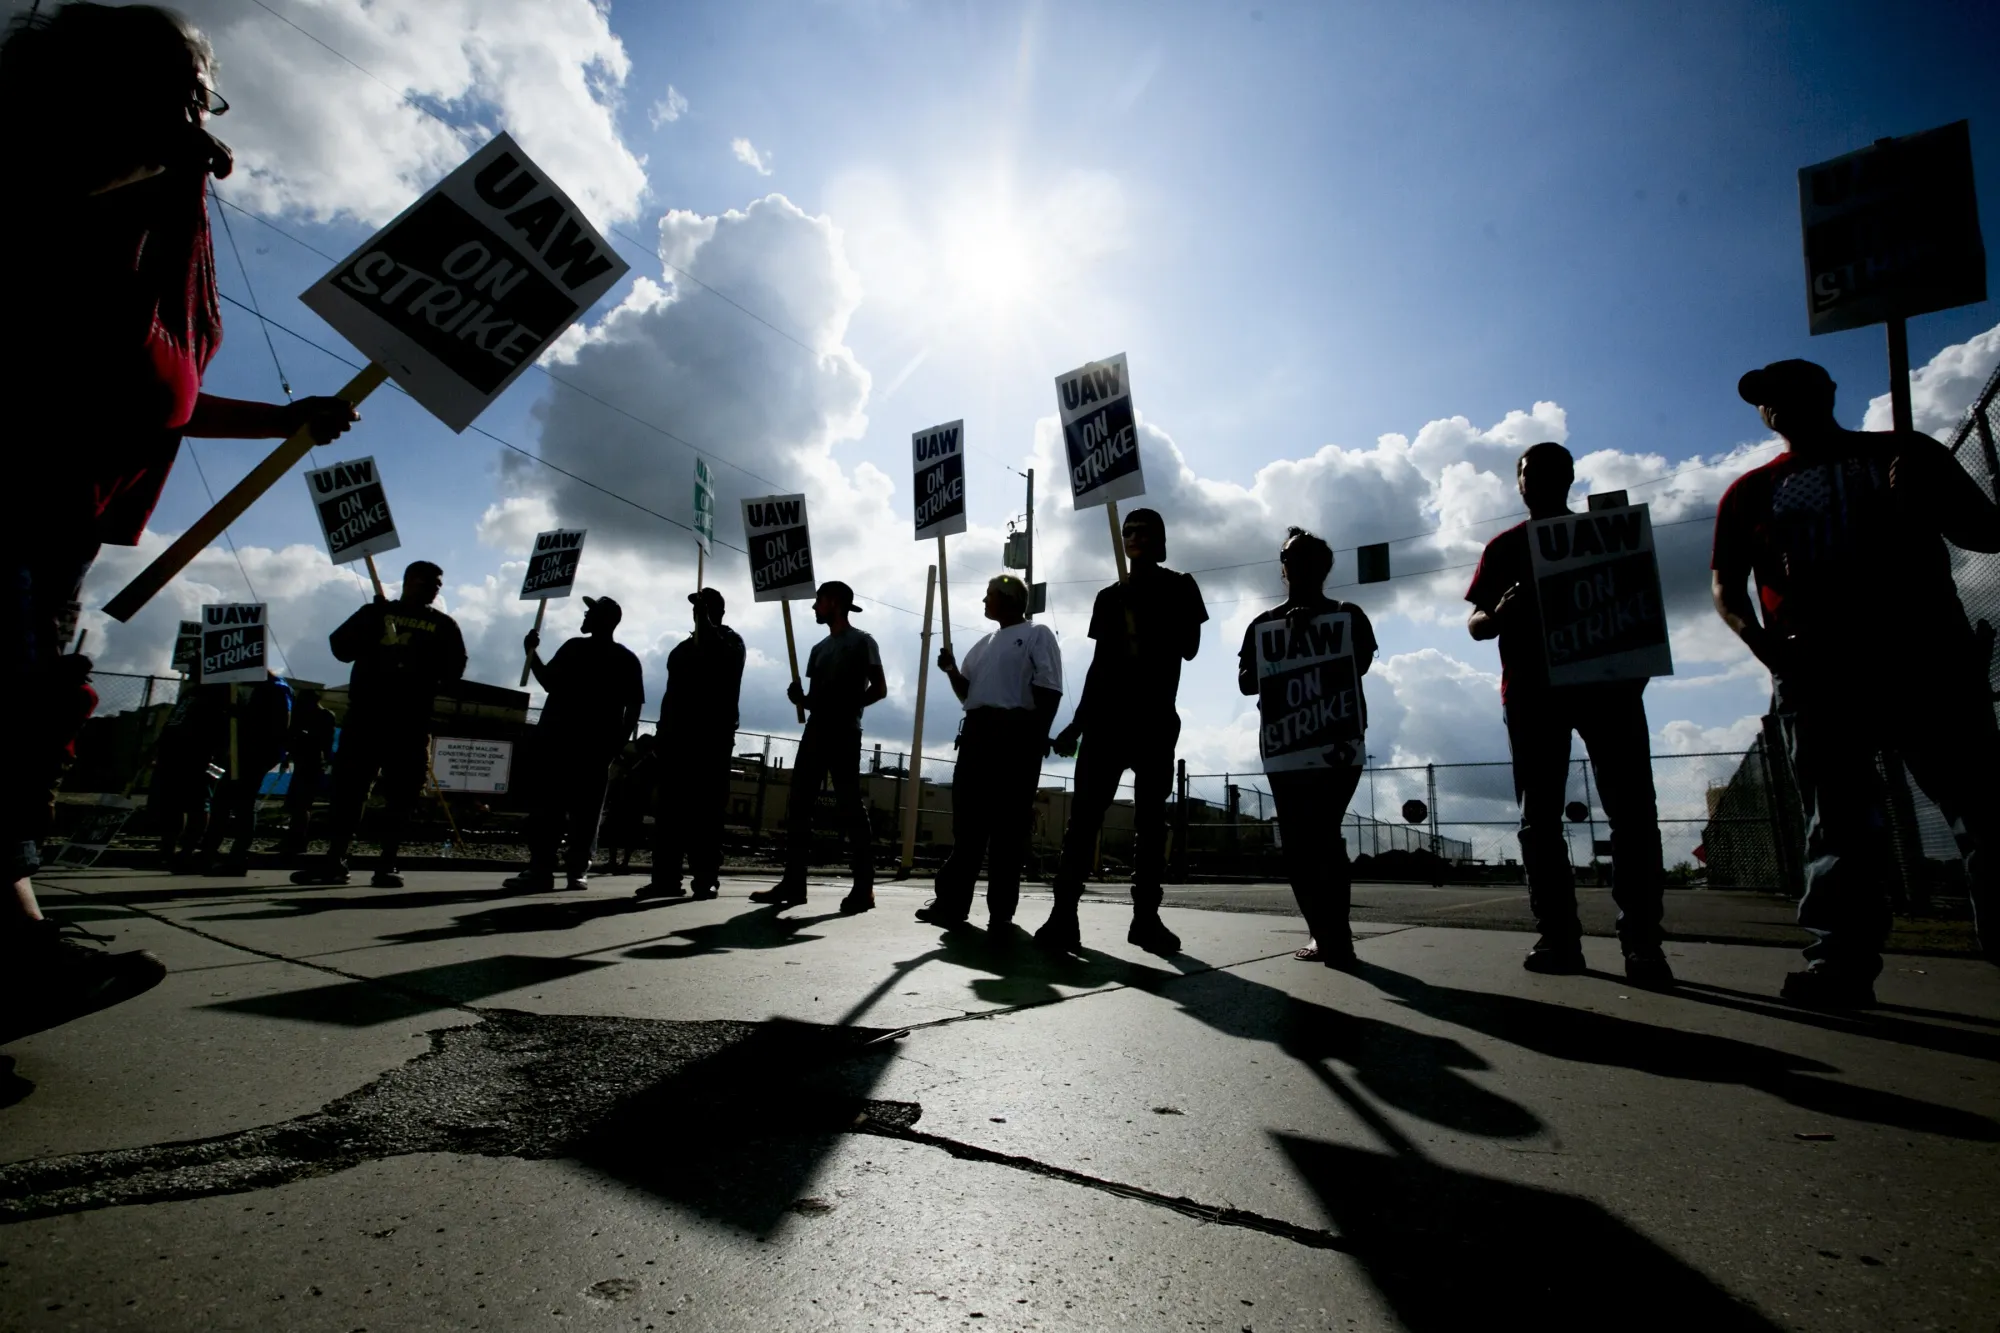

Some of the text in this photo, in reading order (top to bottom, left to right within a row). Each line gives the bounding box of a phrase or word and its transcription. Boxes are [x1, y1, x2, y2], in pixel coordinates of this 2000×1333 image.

[474, 151, 613, 290] UAW
[442, 240, 528, 299] ON
[341, 251, 543, 366] STRIKE
[1062, 363, 1121, 411] UAW
[915, 428, 959, 462] UAW
[1082, 410, 1109, 450] ON
[312, 461, 373, 494] UAW
[926, 464, 945, 494] ON
[1073, 424, 1135, 492] STRIKE
[338, 492, 364, 520] ON
[747, 500, 801, 527] UAW
[915, 477, 962, 528] STRIKE
[329, 501, 389, 550] STRIKE
[537, 532, 582, 550] UAW
[765, 533, 788, 560] ON
[1536, 511, 1642, 562] UAW
[524, 561, 575, 592] STRIKE
[541, 551, 562, 569] ON
[754, 547, 810, 590] STRIKE
[1573, 566, 1616, 612] ON
[207, 606, 262, 626] UAW
[1547, 589, 1658, 662] STRIKE
[204, 640, 264, 674] STRIKE
[220, 629, 244, 649] ON
[1261, 620, 1345, 663] UAW
[1286, 666, 1322, 709] ON
[1264, 689, 1354, 753] STRIKE
